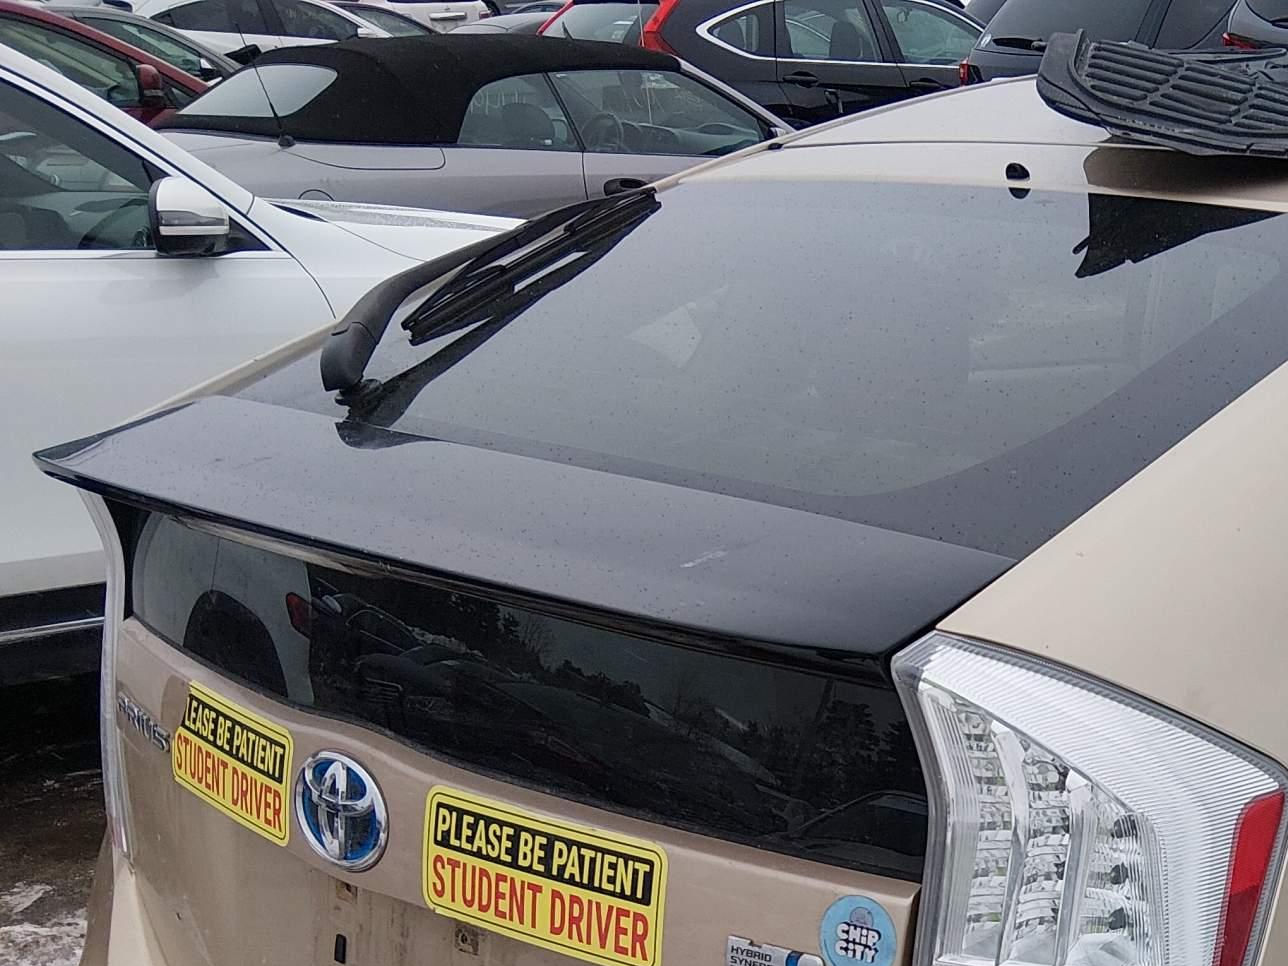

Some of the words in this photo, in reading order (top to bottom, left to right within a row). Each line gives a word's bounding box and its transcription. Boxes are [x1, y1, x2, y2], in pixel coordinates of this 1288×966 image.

[118, 691, 170, 752] PRIUS
[185, 697, 214, 742] LEASE
[216, 716, 231, 750] BE
[233, 726, 284, 779] PATIENT
[176, 732, 228, 801] STUDENT
[231, 766, 283, 833] DRIVER
[436, 807, 514, 862] PLEASE
[517, 831, 547, 873] BE
[551, 840, 650, 899] PATIENT
[432, 854, 543, 929] STUDENT
[549, 888, 649, 961] DRIVER
[730, 945, 772, 962] HYBRID
